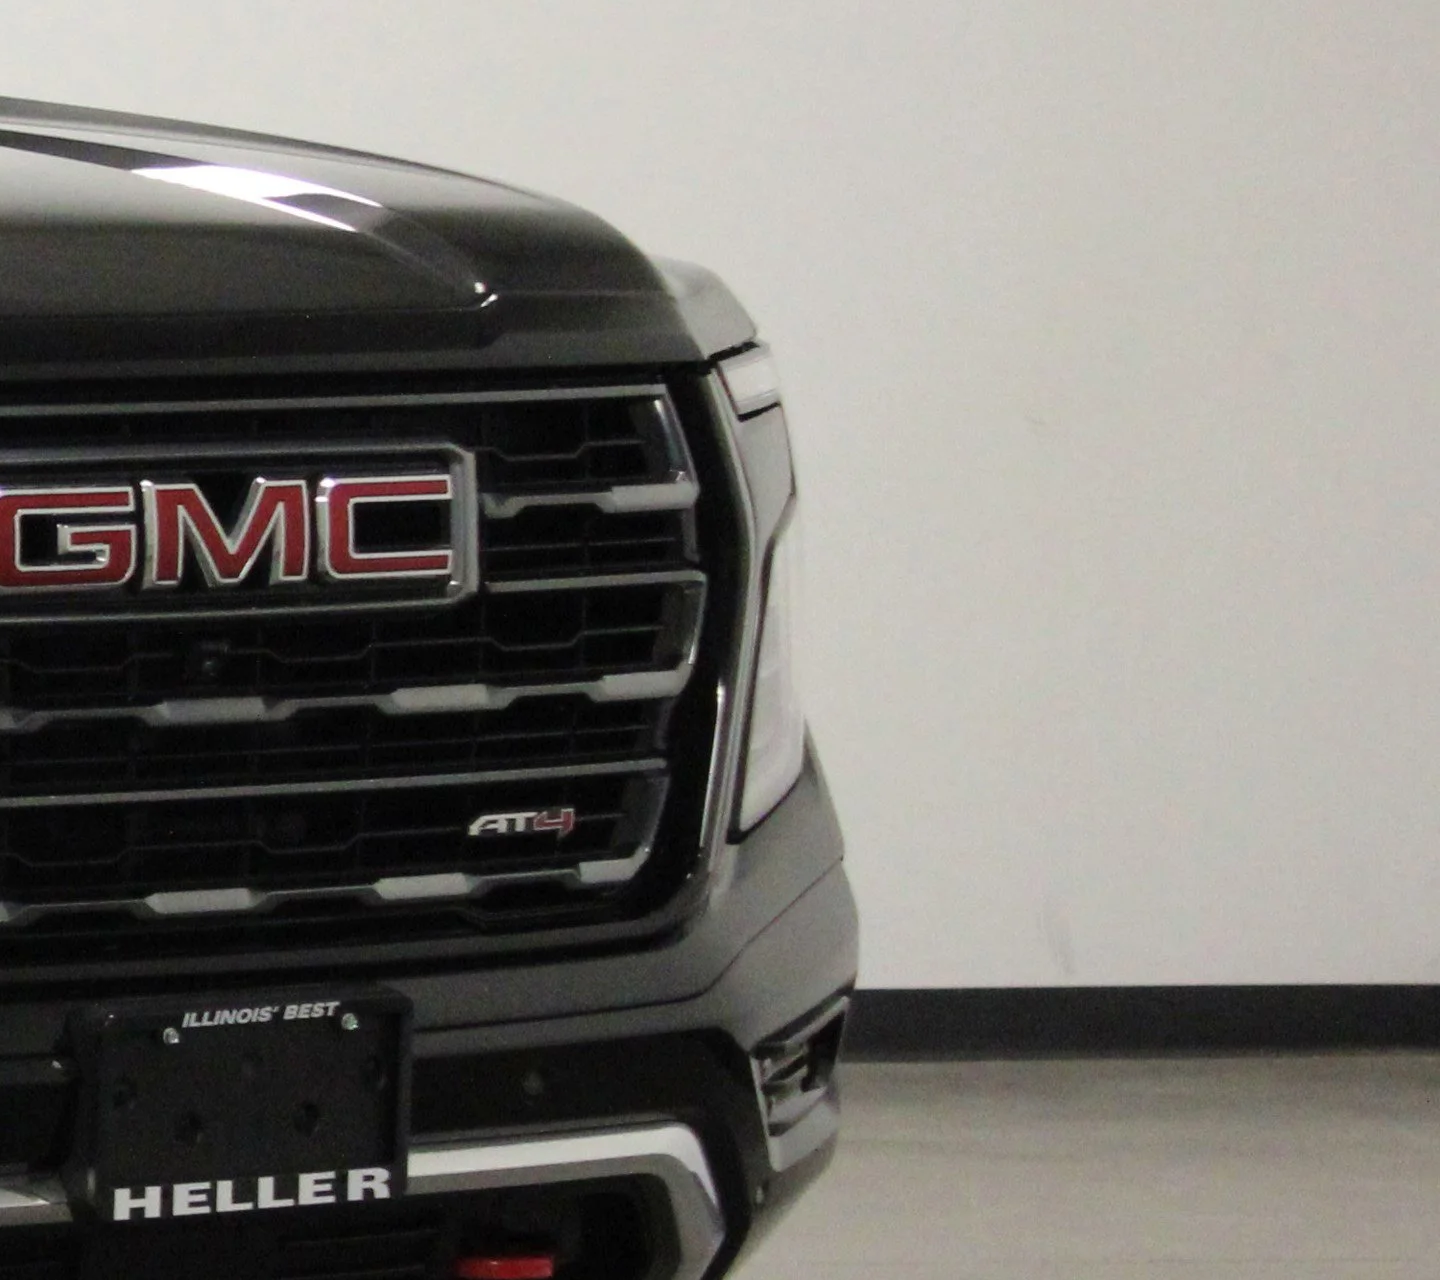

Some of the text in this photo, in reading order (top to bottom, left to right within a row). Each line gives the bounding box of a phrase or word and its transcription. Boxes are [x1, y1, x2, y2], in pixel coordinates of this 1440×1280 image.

[467, 807, 577, 841] AT4
[181, 1000, 341, 1029] ILLINOIS' BEST
[112, 1166, 393, 1222] HELLER
